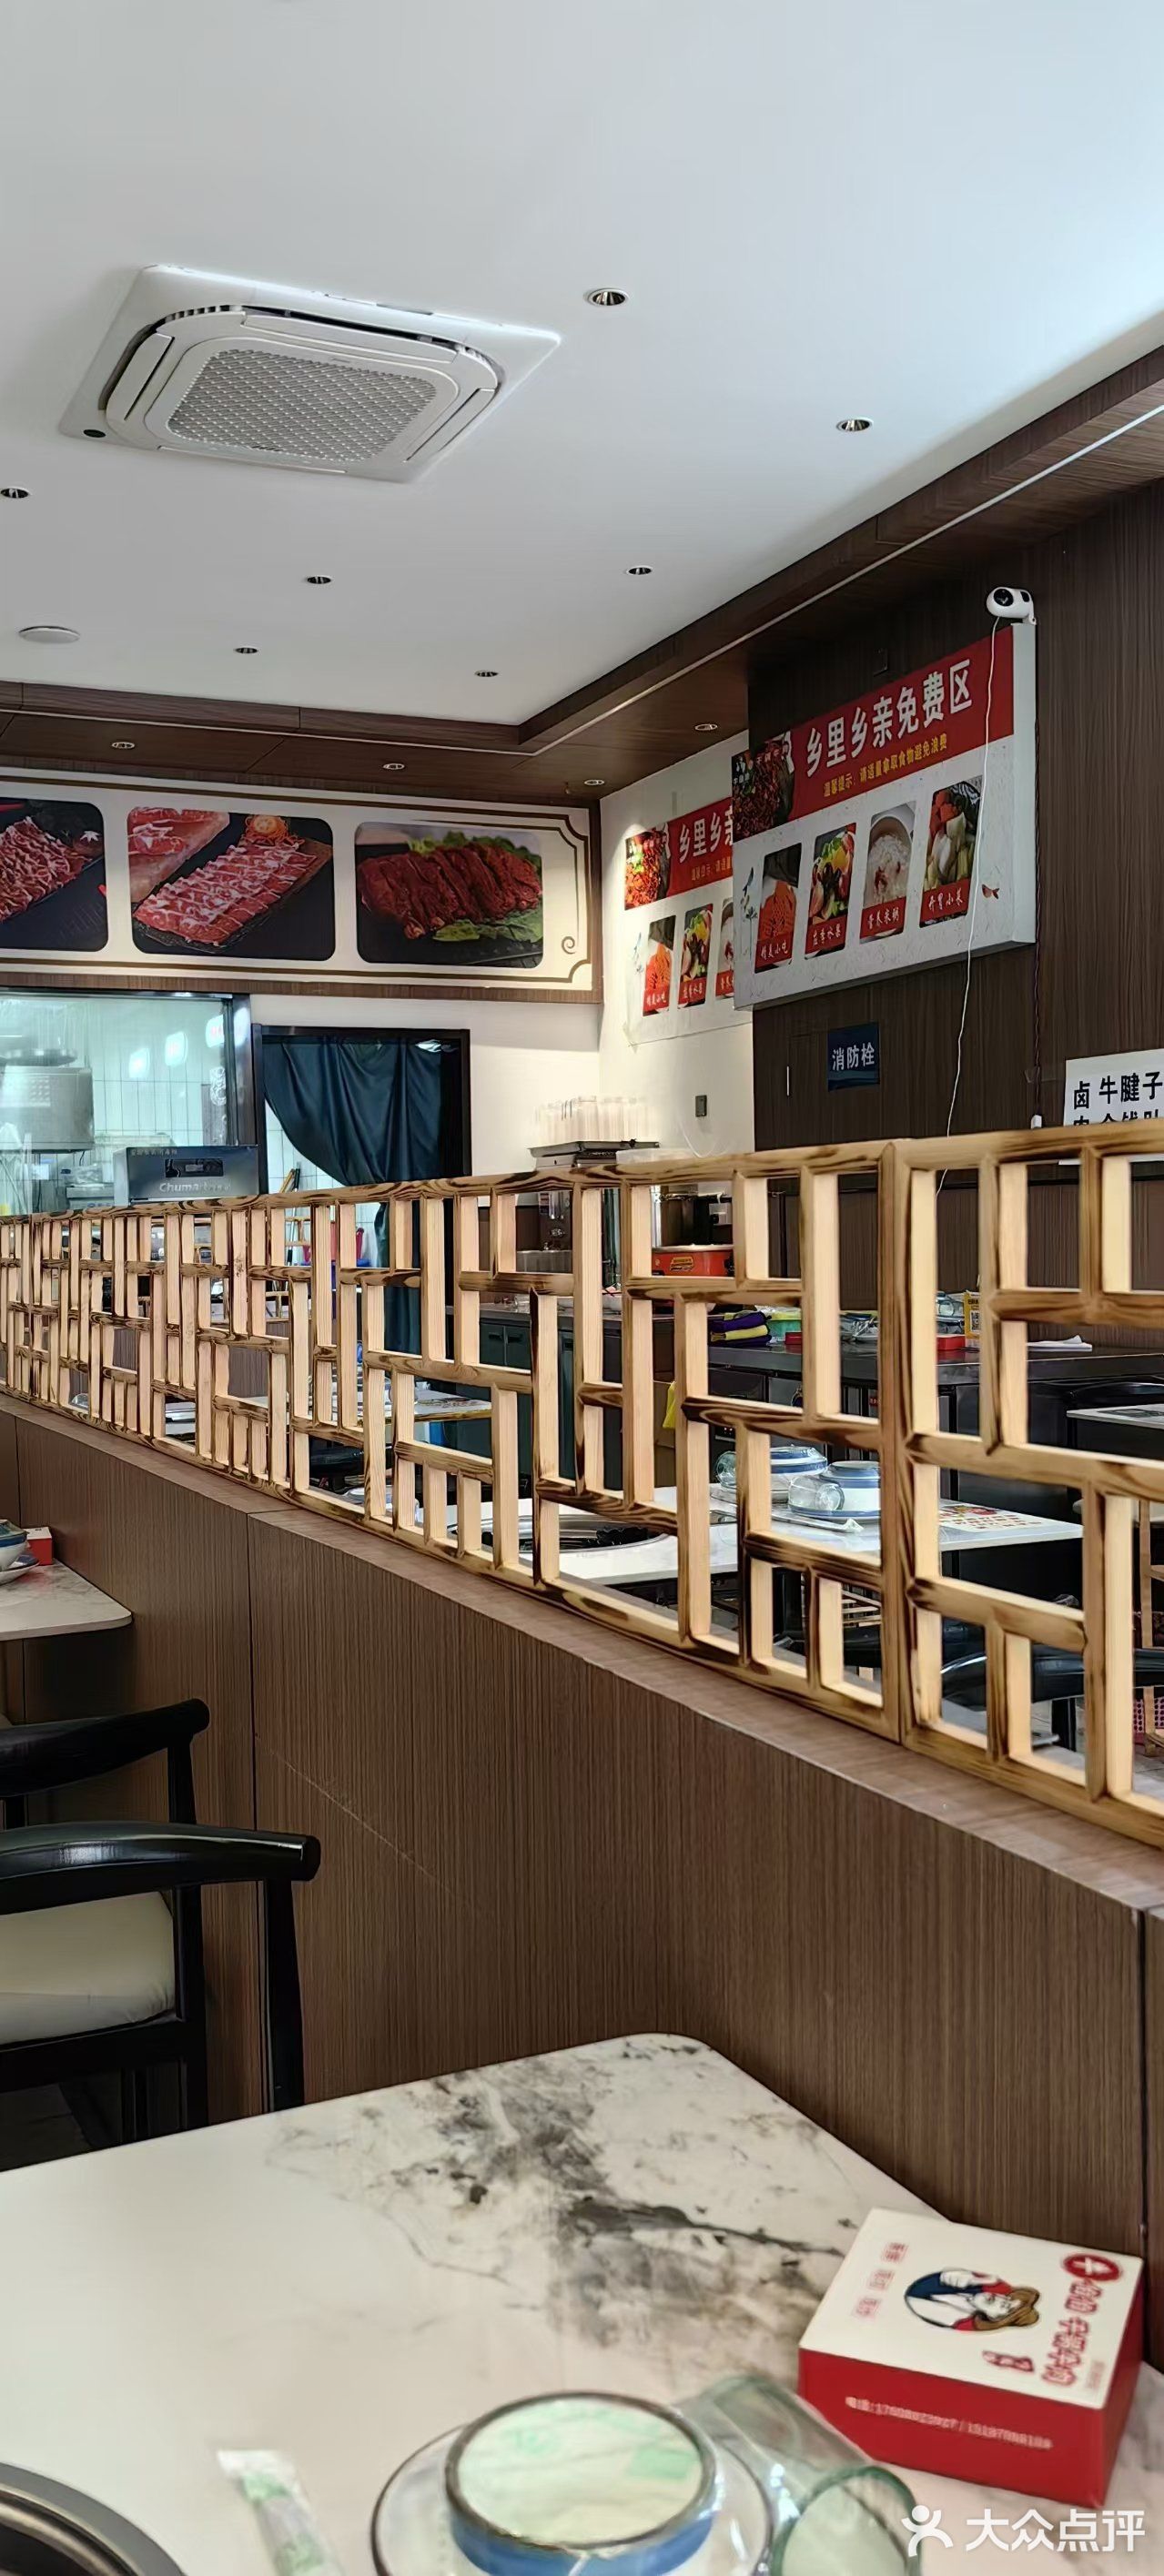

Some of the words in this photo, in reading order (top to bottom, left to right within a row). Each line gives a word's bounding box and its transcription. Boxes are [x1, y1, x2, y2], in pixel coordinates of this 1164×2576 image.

[806, 659, 973, 778] 乡里乡亲免费区
[832, 1042, 875, 1071] 消防栓
